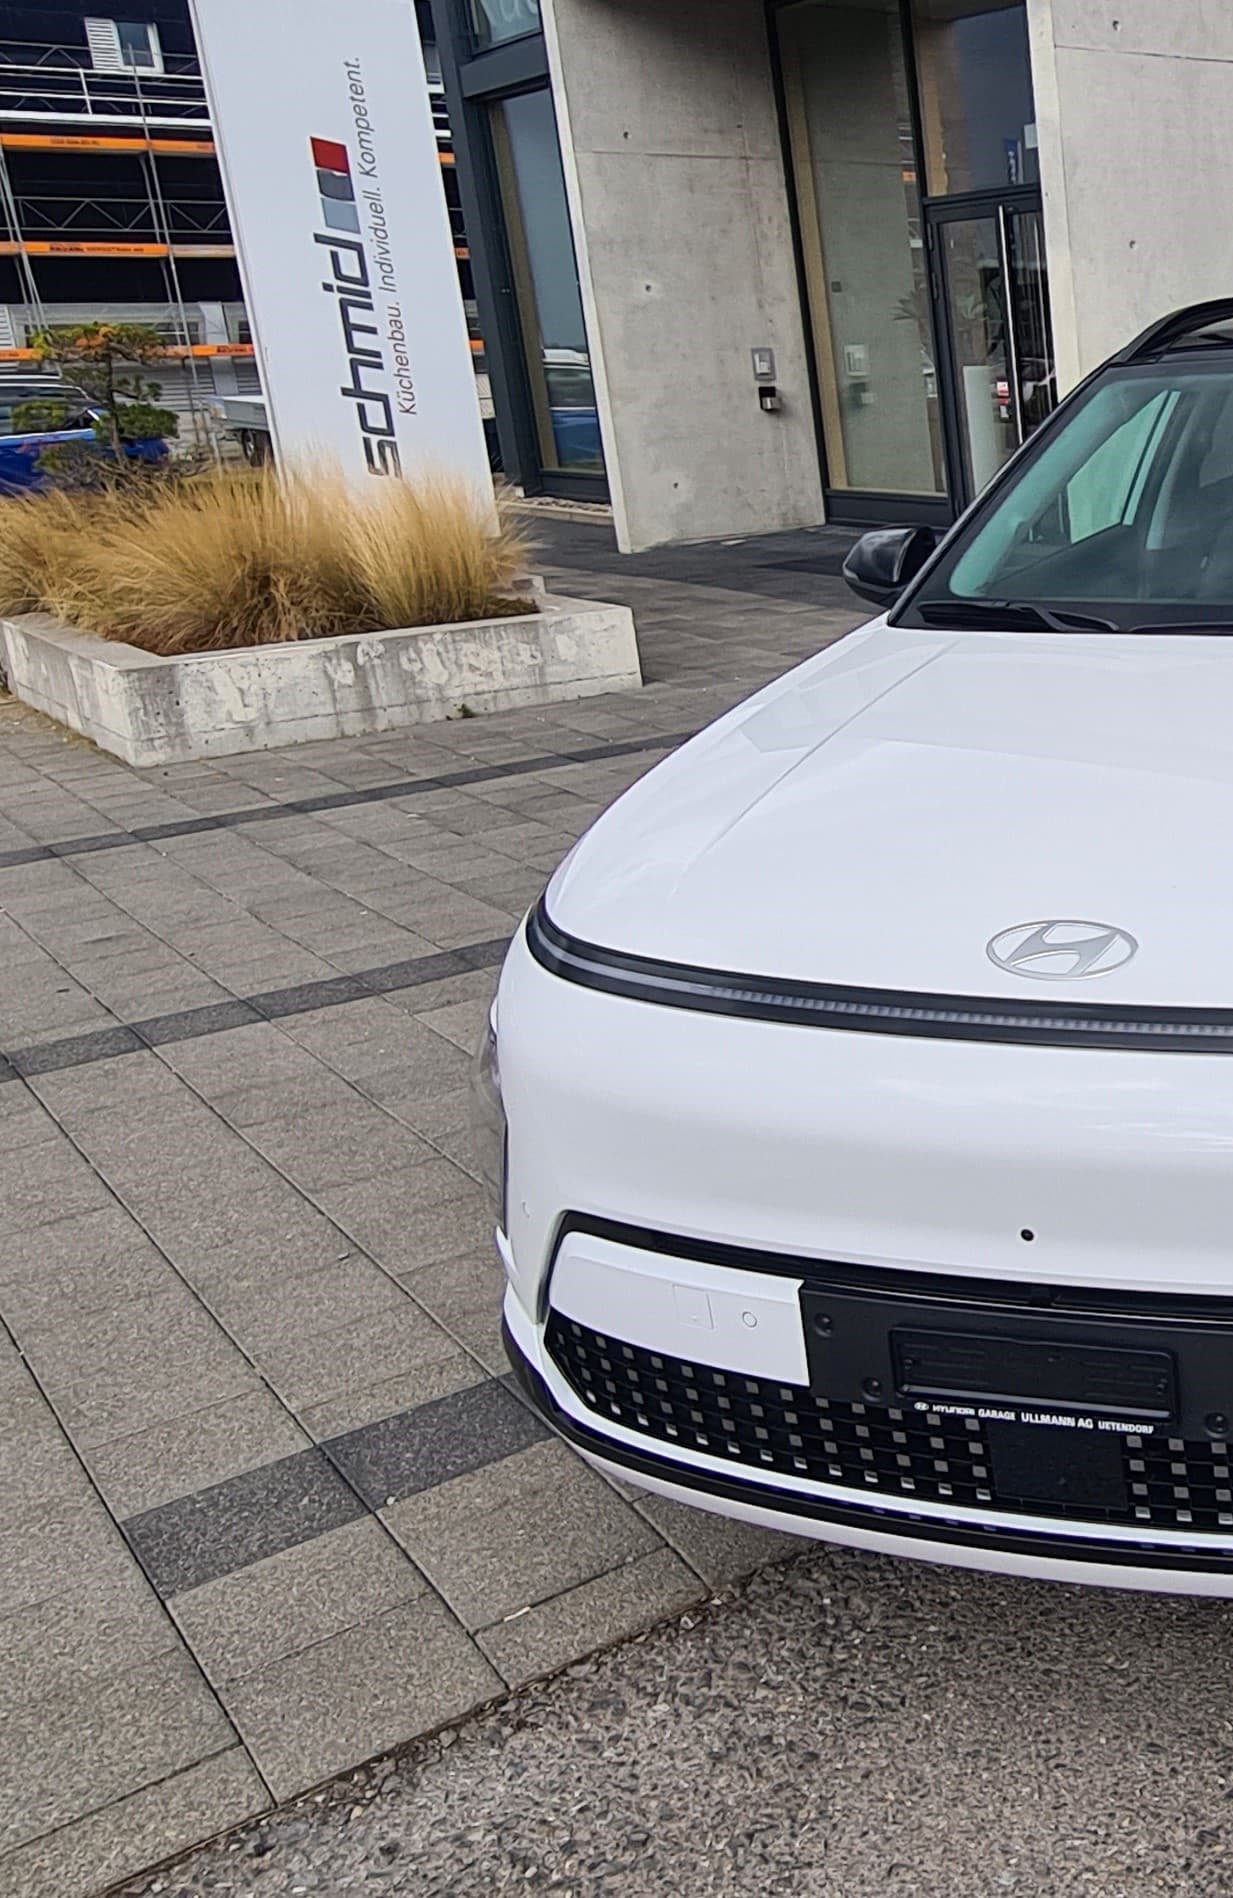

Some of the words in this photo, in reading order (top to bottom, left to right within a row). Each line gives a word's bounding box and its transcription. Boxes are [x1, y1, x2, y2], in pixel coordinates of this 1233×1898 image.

[343, 57, 378, 179] Kompetent.
[362, 186, 397, 293] Individuell.
[313, 233, 401, 478] schmid
[387, 301, 417, 415] Küchenbau.
[978, 1408, 1016, 1421] GARAGE
[1021, 1411, 1076, 1428] ULLMANN
[1077, 1416, 1094, 1429] AG
[1098, 1420, 1154, 1435] UETENDORF
